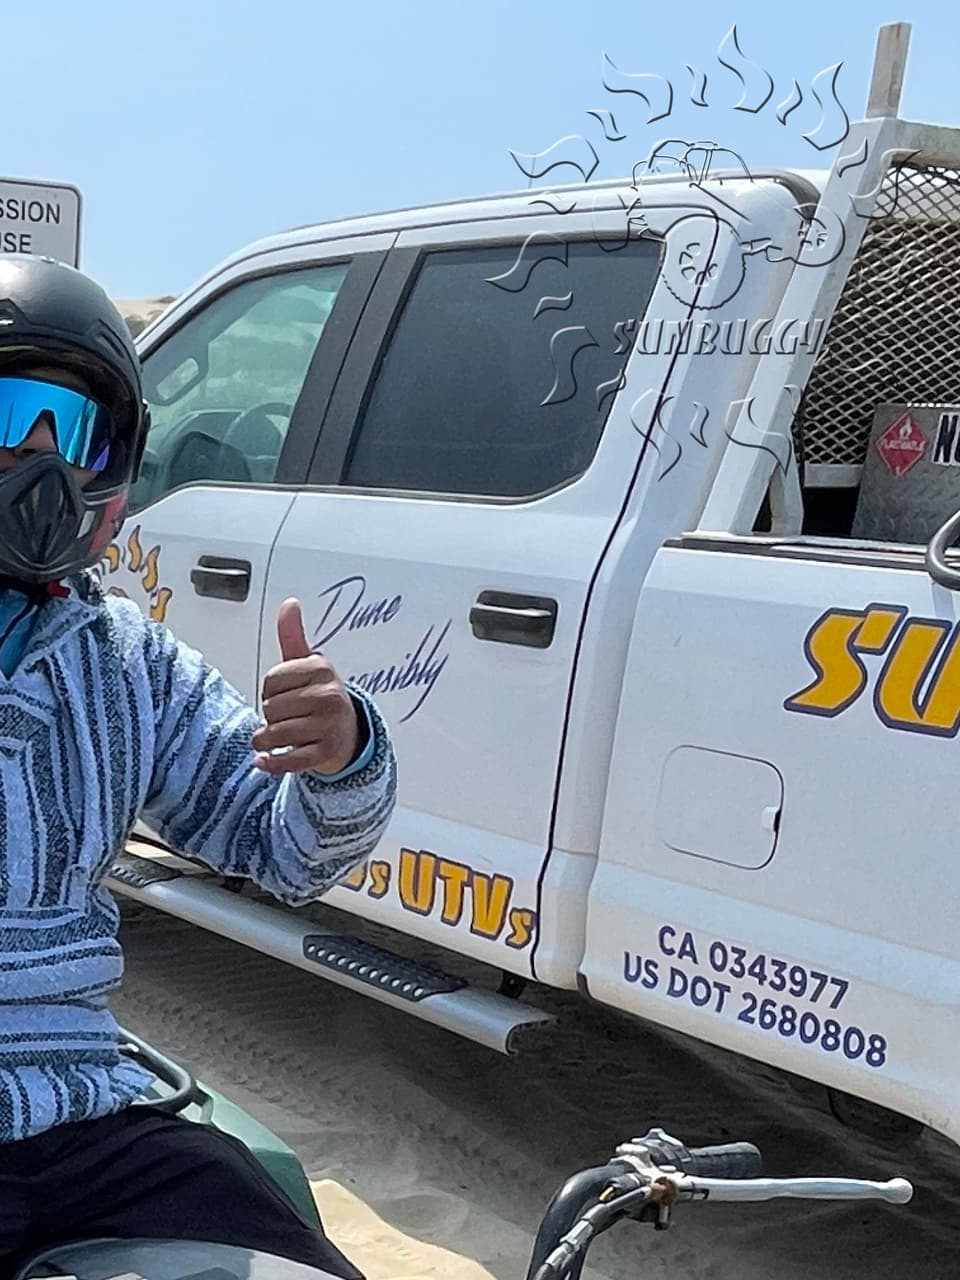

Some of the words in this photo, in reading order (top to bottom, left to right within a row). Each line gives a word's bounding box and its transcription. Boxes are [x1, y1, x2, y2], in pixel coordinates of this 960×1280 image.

[311, 576, 402, 650] Dune
[348, 619, 452, 723] onsibly
[624, 951, 658, 989] US
[667, 966, 731, 1013] DOT
[737, 992, 887, 1067] 2680808
[658, 926, 698, 964] CA
[709, 941, 849, 1009] 0343977
